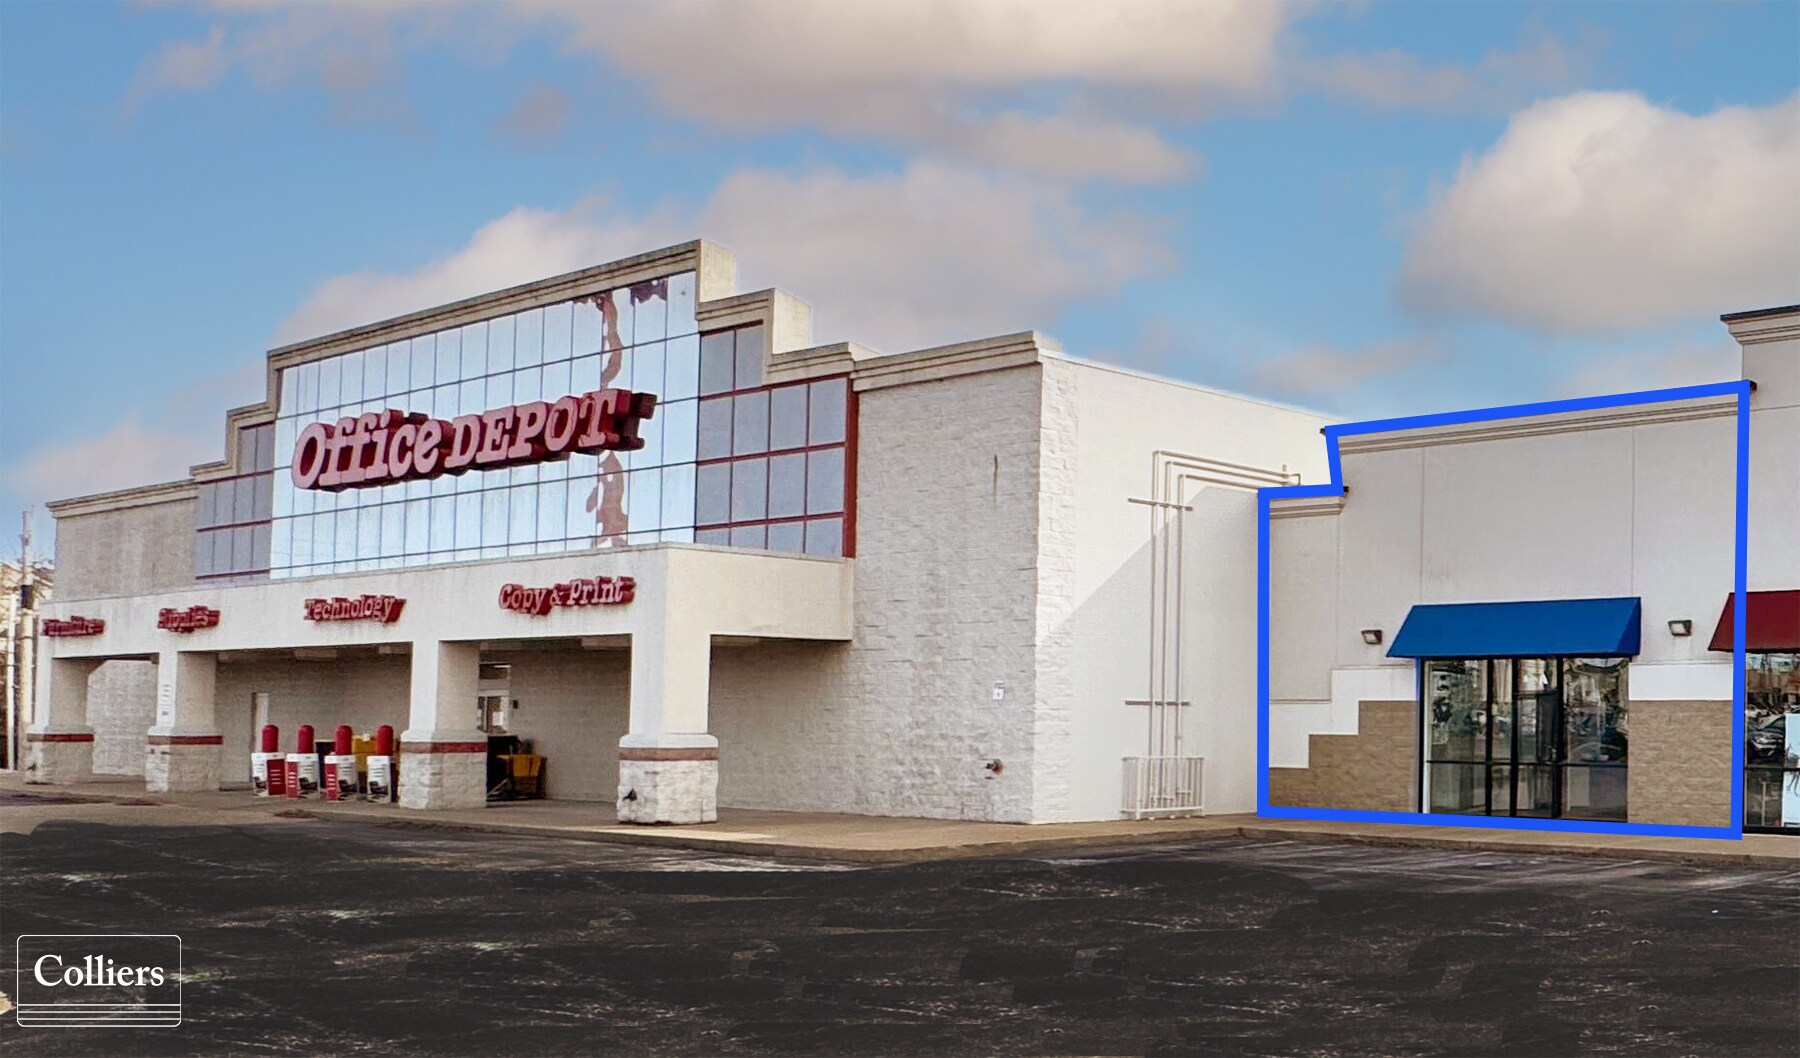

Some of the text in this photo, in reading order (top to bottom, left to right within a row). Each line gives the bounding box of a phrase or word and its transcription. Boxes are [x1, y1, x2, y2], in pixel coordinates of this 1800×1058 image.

[291, 388, 628, 490] Office DEPOT
[304, 595, 398, 622] Technology
[499, 584, 548, 614] Copy
[568, 576, 628, 605] Print
